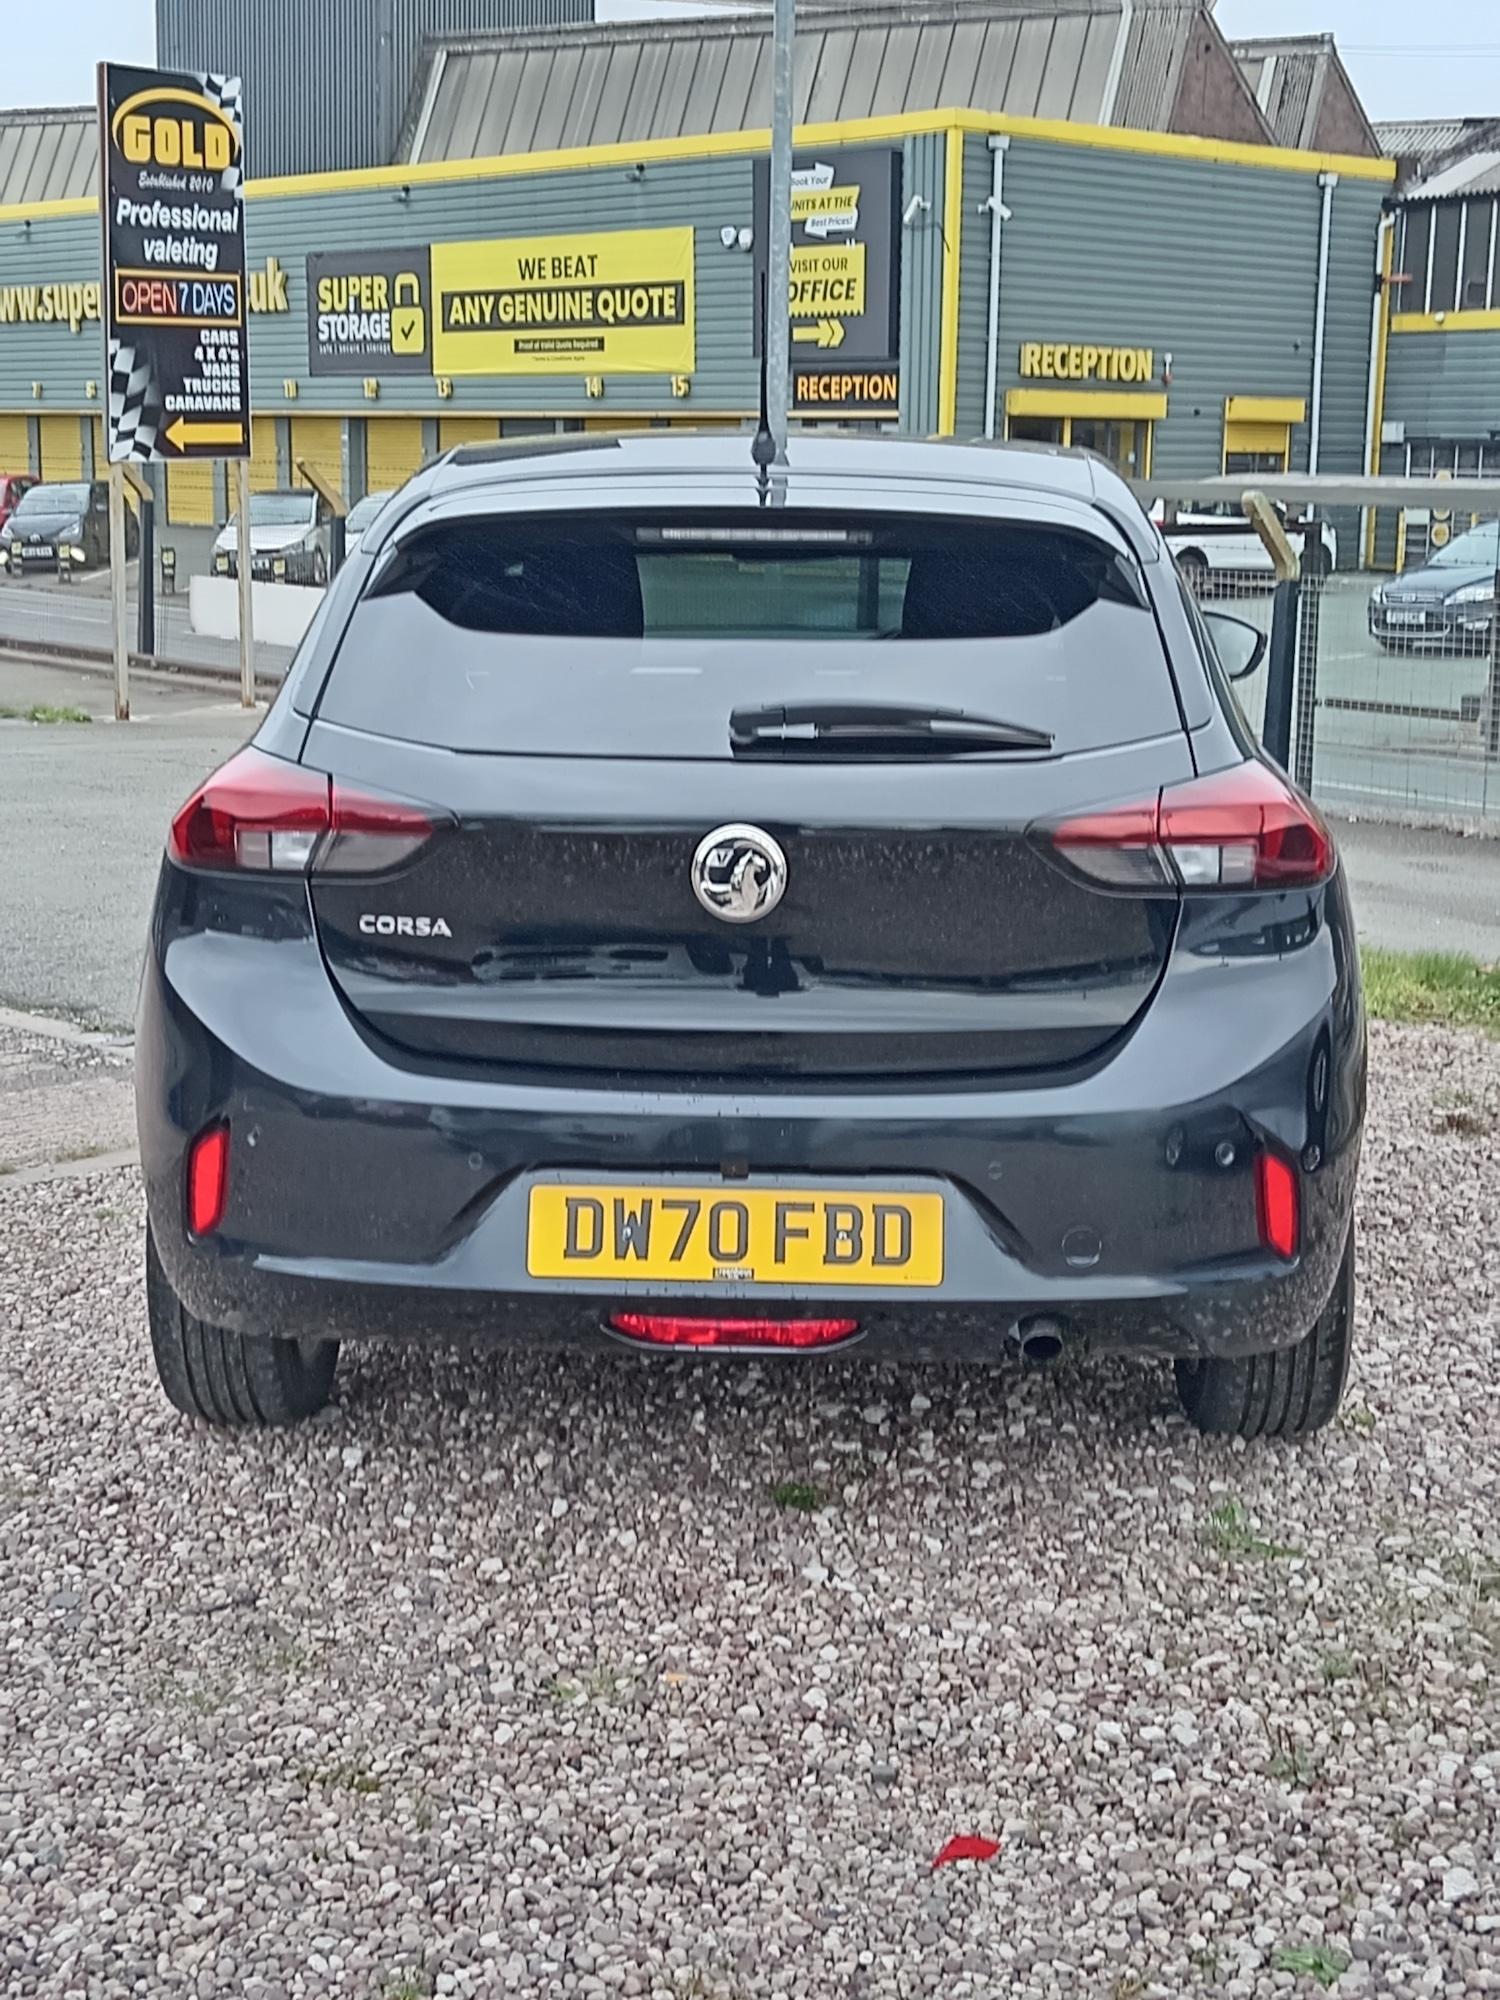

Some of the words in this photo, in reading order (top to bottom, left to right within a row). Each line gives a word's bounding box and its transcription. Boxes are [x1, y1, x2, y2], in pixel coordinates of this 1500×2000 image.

[122, 114, 231, 170] GOLD
[138, 170, 187, 192] Established
[189, 174, 214, 194] 2010
[811, 176, 829, 185] Your
[819, 197, 832, 210] AT
[834, 196, 854, 209] THE
[116, 198, 239, 233] Professional
[811, 218, 827, 227] Best
[828, 216, 854, 227] Prices!
[143, 234, 218, 271] valeting
[518, 257, 547, 281] WE
[551, 254, 598, 279] BEAT
[789, 258, 819, 274] VISIT
[821, 257, 848, 272] OUR
[122, 280, 177, 315] OPEN
[178, 283, 189, 314] 7
[192, 283, 236, 316] DAYS
[318, 275, 389, 312] SUPER
[788, 277, 857, 304] OFFICE
[450, 295, 495, 325] ANY
[498, 290, 593, 324] GENUINE
[597, 286, 676, 324] QUOTE
[200, 329, 239, 346] CARS
[318, 312, 391, 342] STORAGE
[194, 346, 204, 361] 4
[218, 347, 239, 361] 4's
[1020, 342, 1153, 382] RECEPTION
[201, 362, 240, 378] VANS
[183, 377, 241, 394] TRUCKS
[436, 376, 453, 398] 13
[584, 375, 603, 398] 14
[670, 374, 690, 398] 15
[797, 373, 897, 401] RECEPTION
[165, 394, 241, 412] CARAVANS
[359, 914, 453, 938] CORSA
[563, 1196, 750, 1263] DW70
[774, 1201, 912, 1267] FBD
